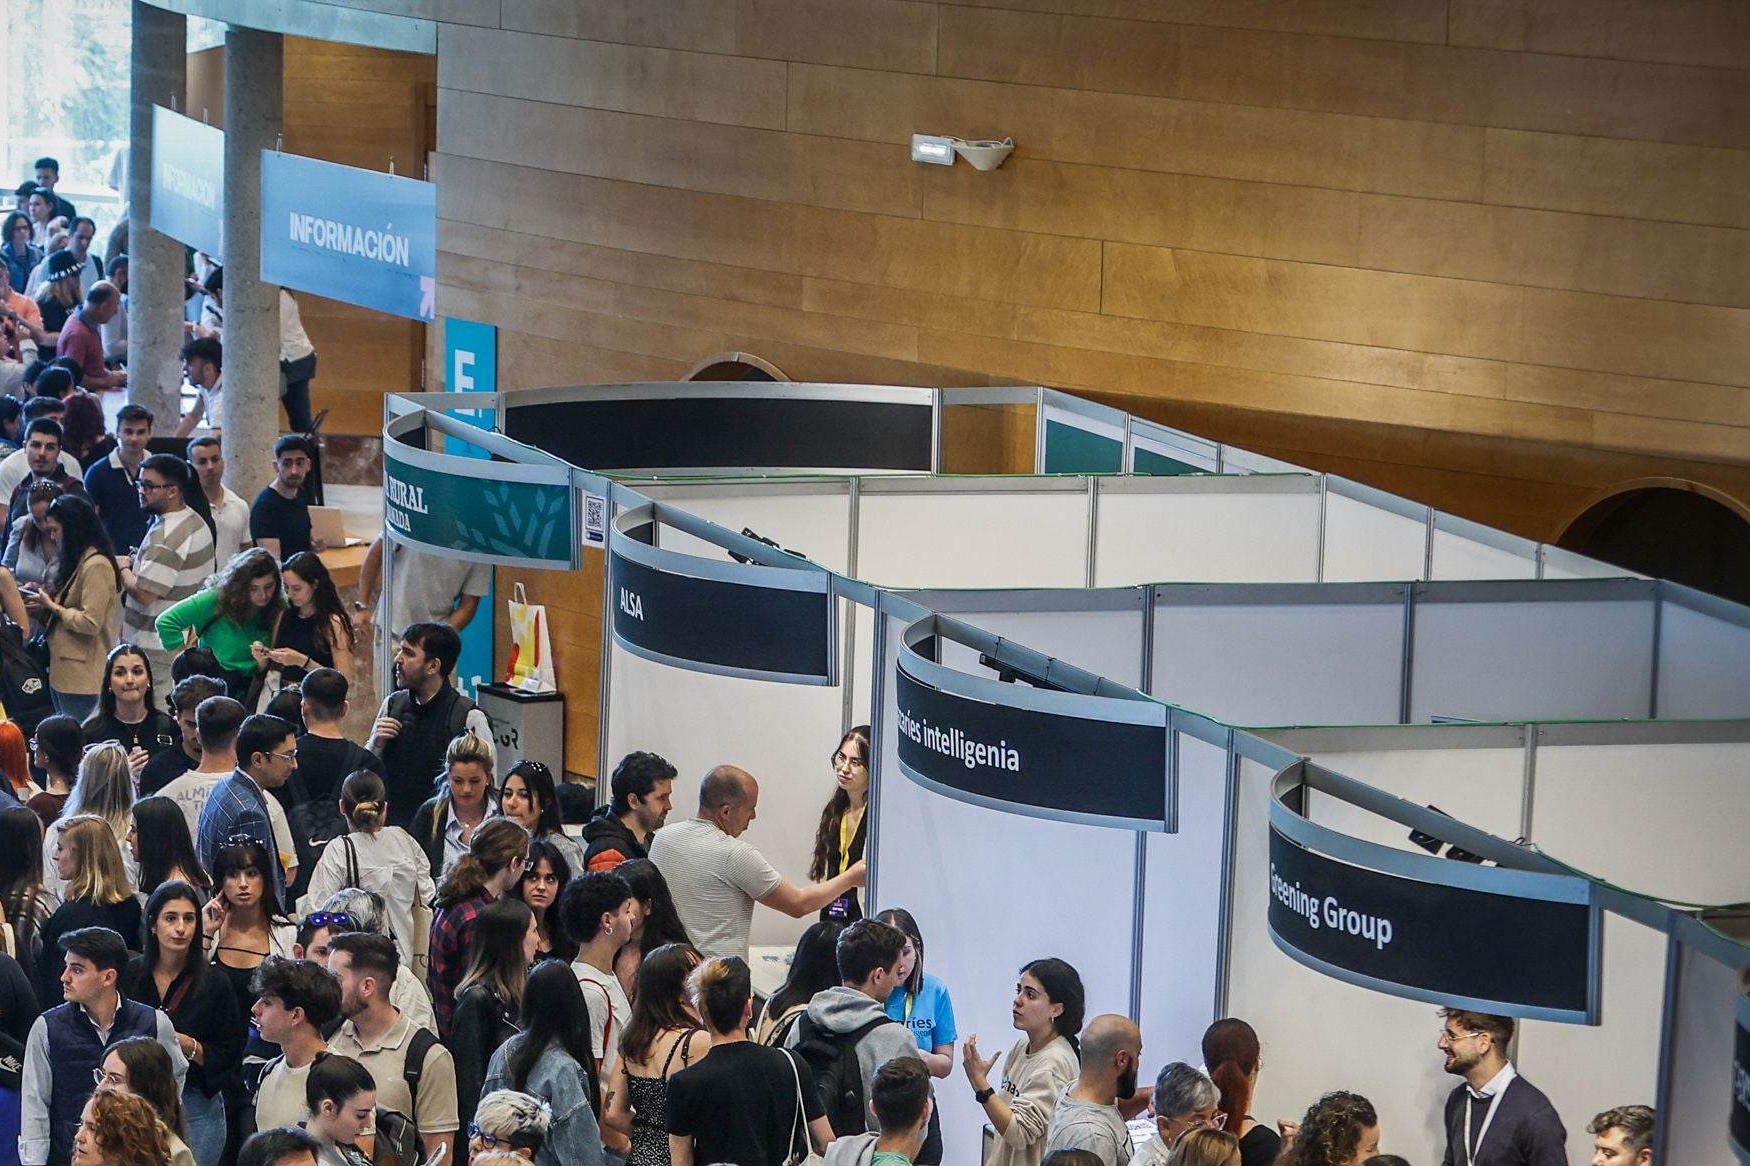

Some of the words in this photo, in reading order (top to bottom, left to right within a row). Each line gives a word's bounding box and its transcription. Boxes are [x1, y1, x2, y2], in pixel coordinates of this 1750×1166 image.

[289, 211, 410, 268] INFORMACIÓN
[389, 475, 429, 515] RURAL
[619, 586, 645, 622] ALSA
[898, 709, 922, 744] aríes
[923, 718, 1020, 772] intelligenia
[1270, 861, 1320, 929] Greening
[1323, 896, 1393, 950] Group
[905, 1016, 932, 1029] ríes
